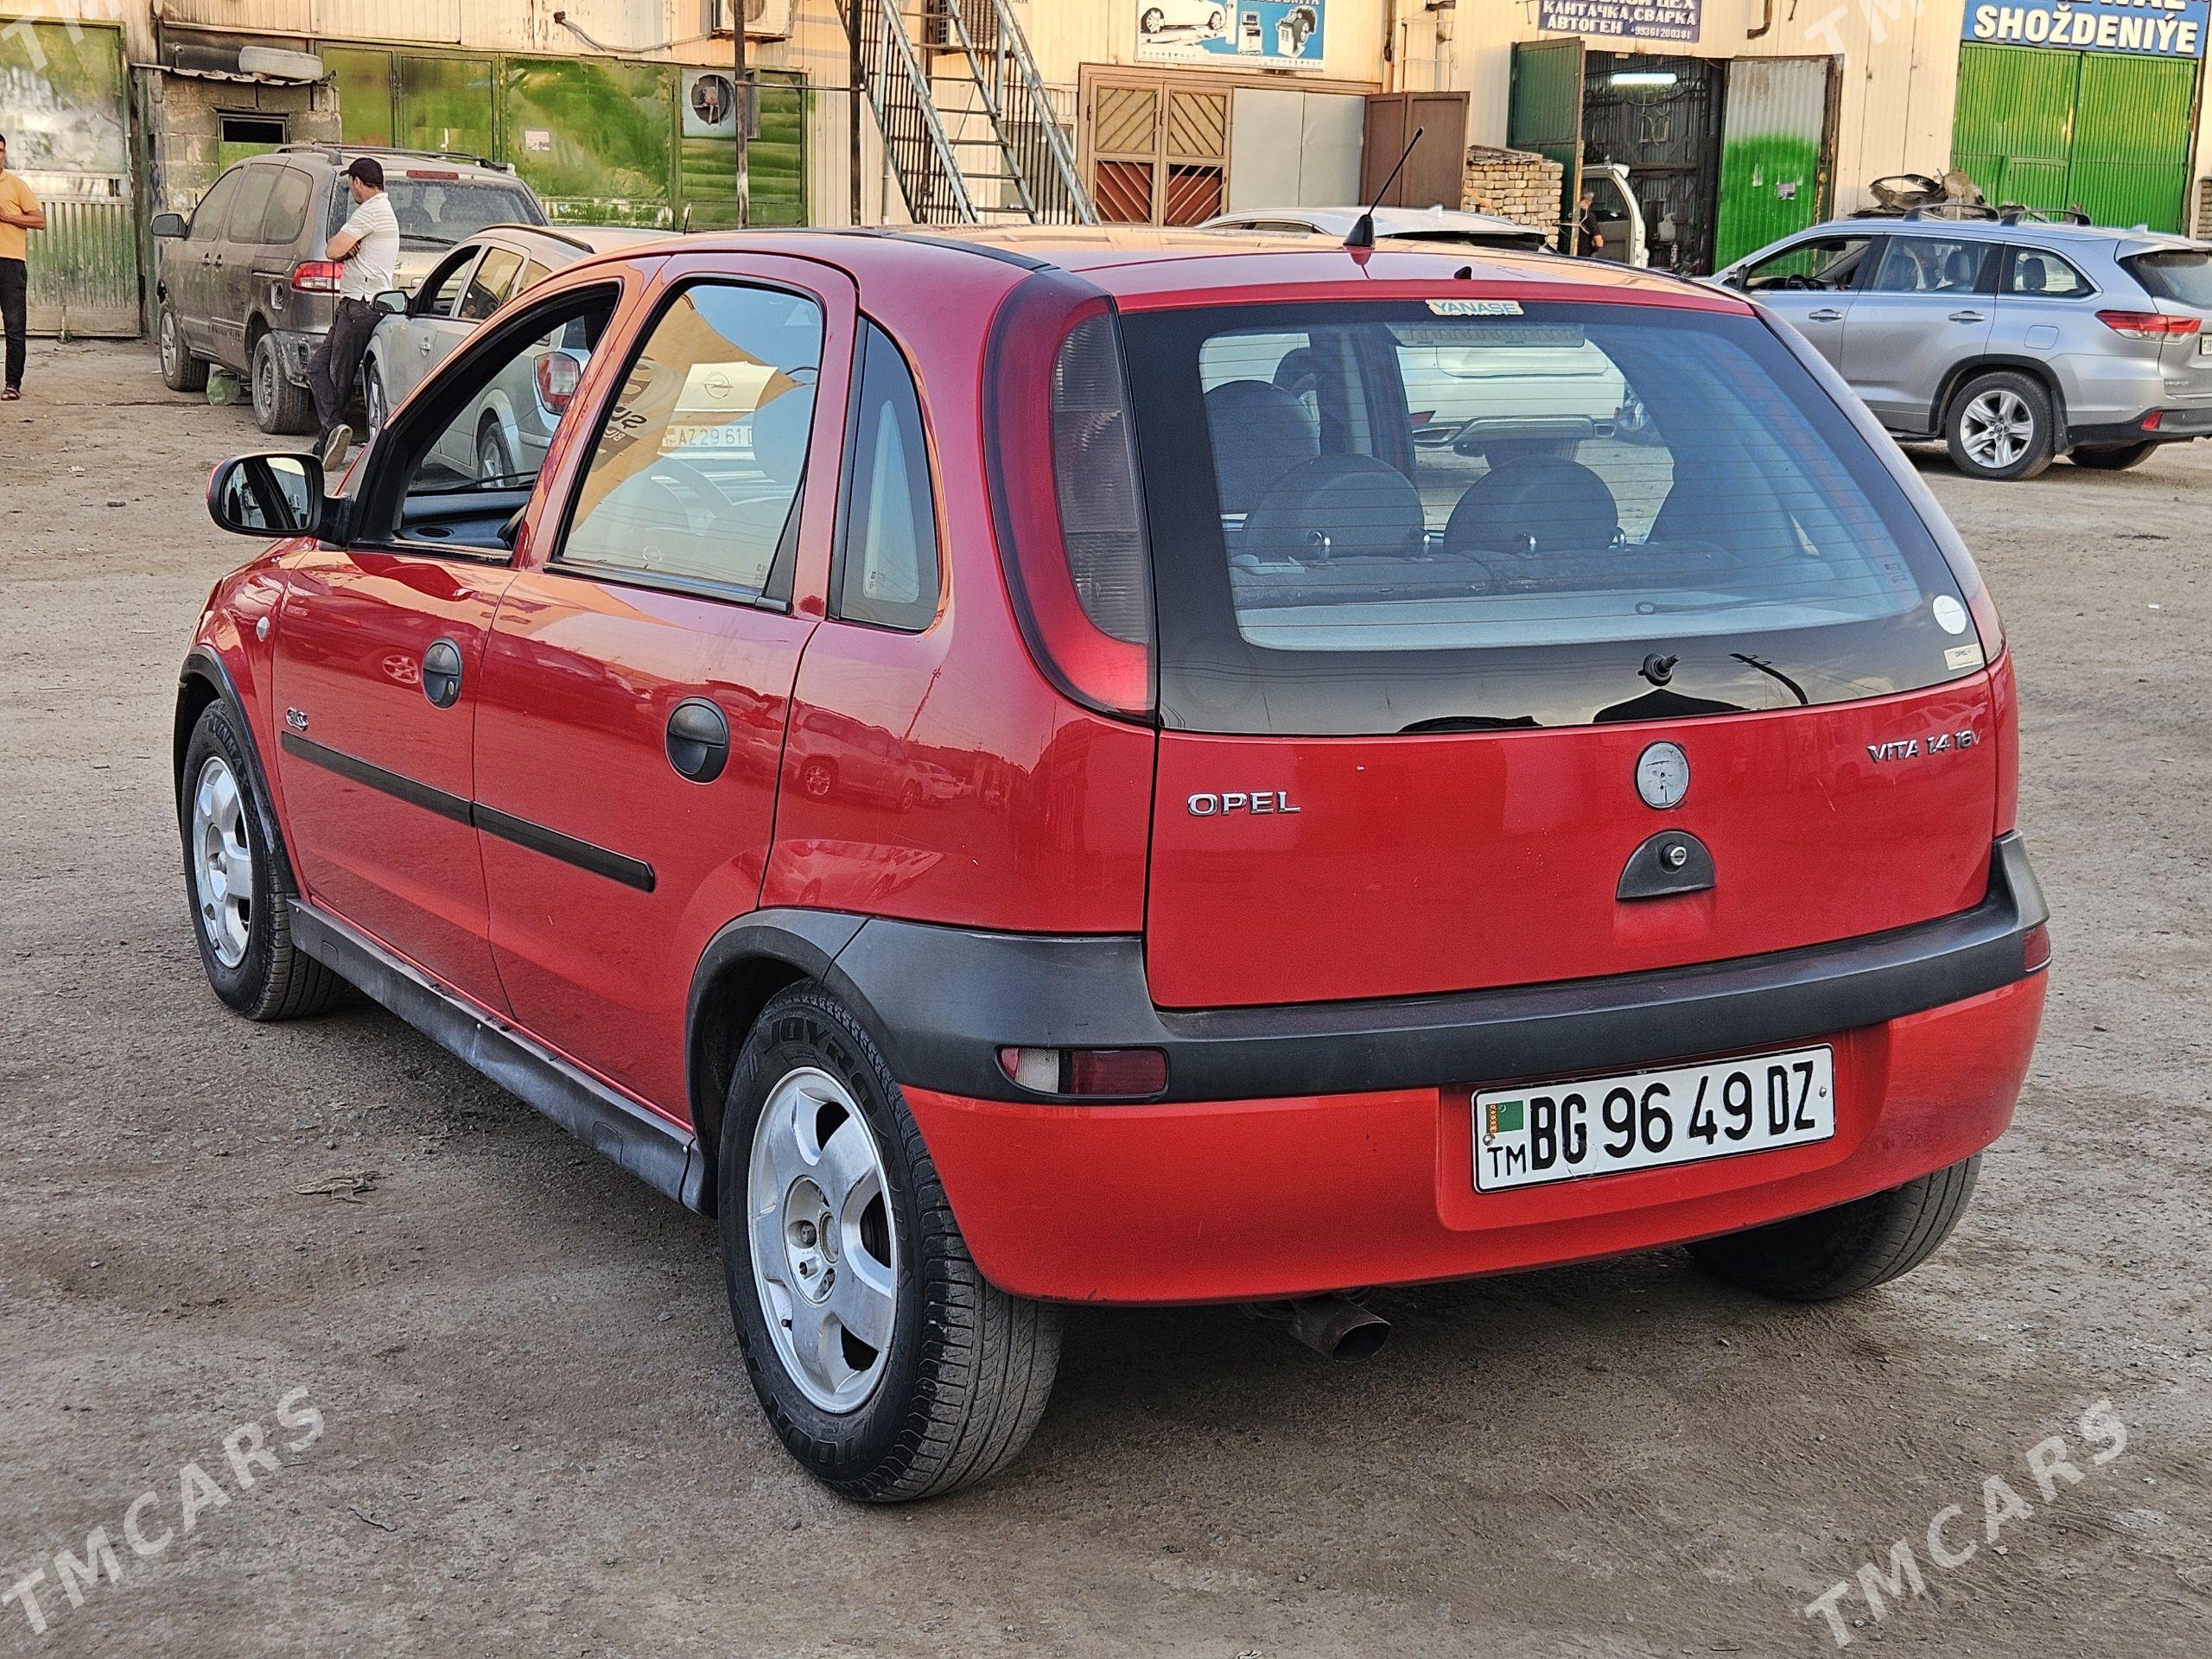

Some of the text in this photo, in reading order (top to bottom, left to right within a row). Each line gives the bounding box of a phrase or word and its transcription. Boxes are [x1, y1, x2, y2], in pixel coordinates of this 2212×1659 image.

[1547, 14, 1624, 35] АВТОГЕН
[1974, 3, 2199, 54] SHOŽDENIÝE
[1433, 302, 1519, 314] YANASE
[699, 428, 720, 446] 29
[725, 428, 742, 445] 61
[1867, 739, 1919, 764] VITA
[1954, 728, 1983, 750] 16V
[1187, 791, 1302, 817] OPEL
[1529, 1059, 1815, 1171] BG 96 49 DZ
[1486, 1143, 1527, 1179] TM
